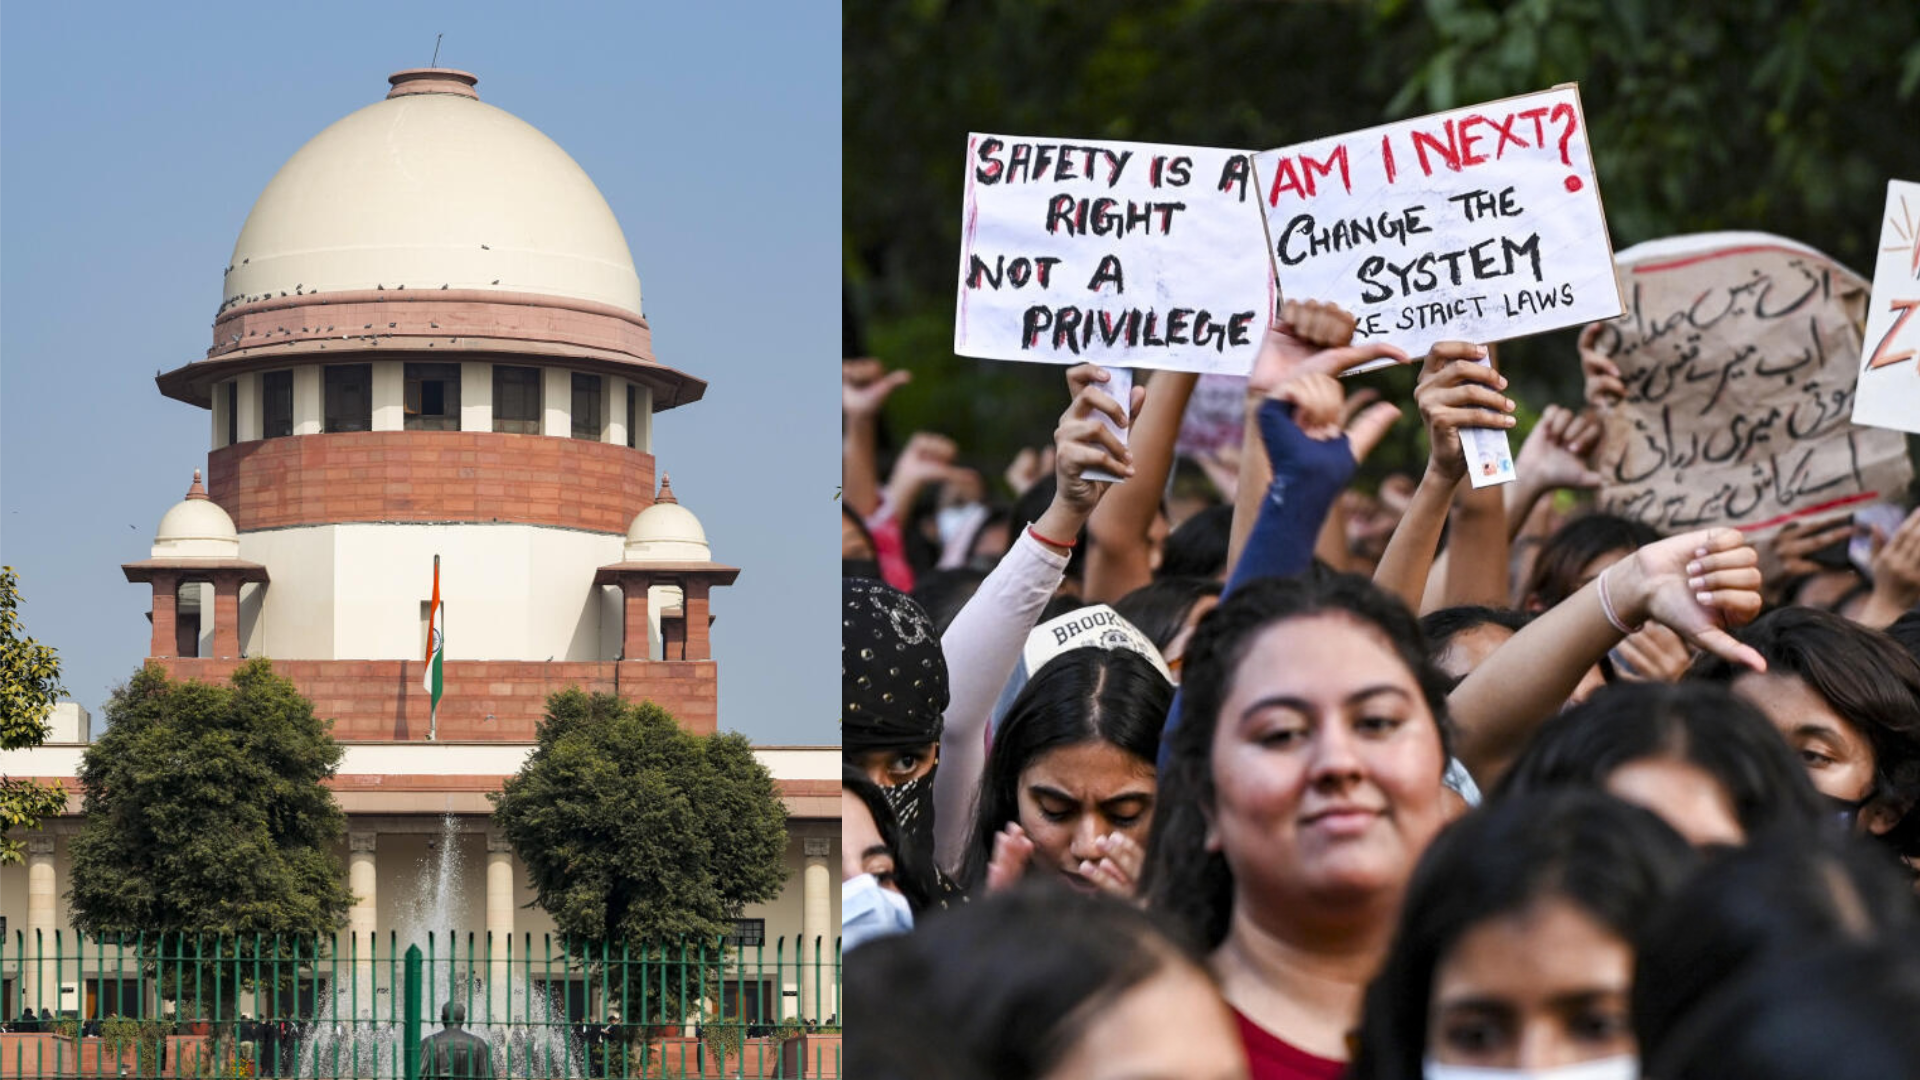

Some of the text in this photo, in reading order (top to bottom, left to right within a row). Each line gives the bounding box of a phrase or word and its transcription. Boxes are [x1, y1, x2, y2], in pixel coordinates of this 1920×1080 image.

[975, 137, 1251, 203] SAFETY IS A
[1268, 102, 1584, 208] AM I NEXT?
[1046, 193, 1187, 239] RIGHT
[1277, 186, 1524, 267] CHANGE THE
[966, 253, 1124, 294] NOT A
[1357, 231, 1543, 305] SYSTEM
[1021, 305, 1255, 354] PRIVILEGE
[1396, 296, 1487, 331] STRICT
[1503, 283, 1575, 318] LAWS
